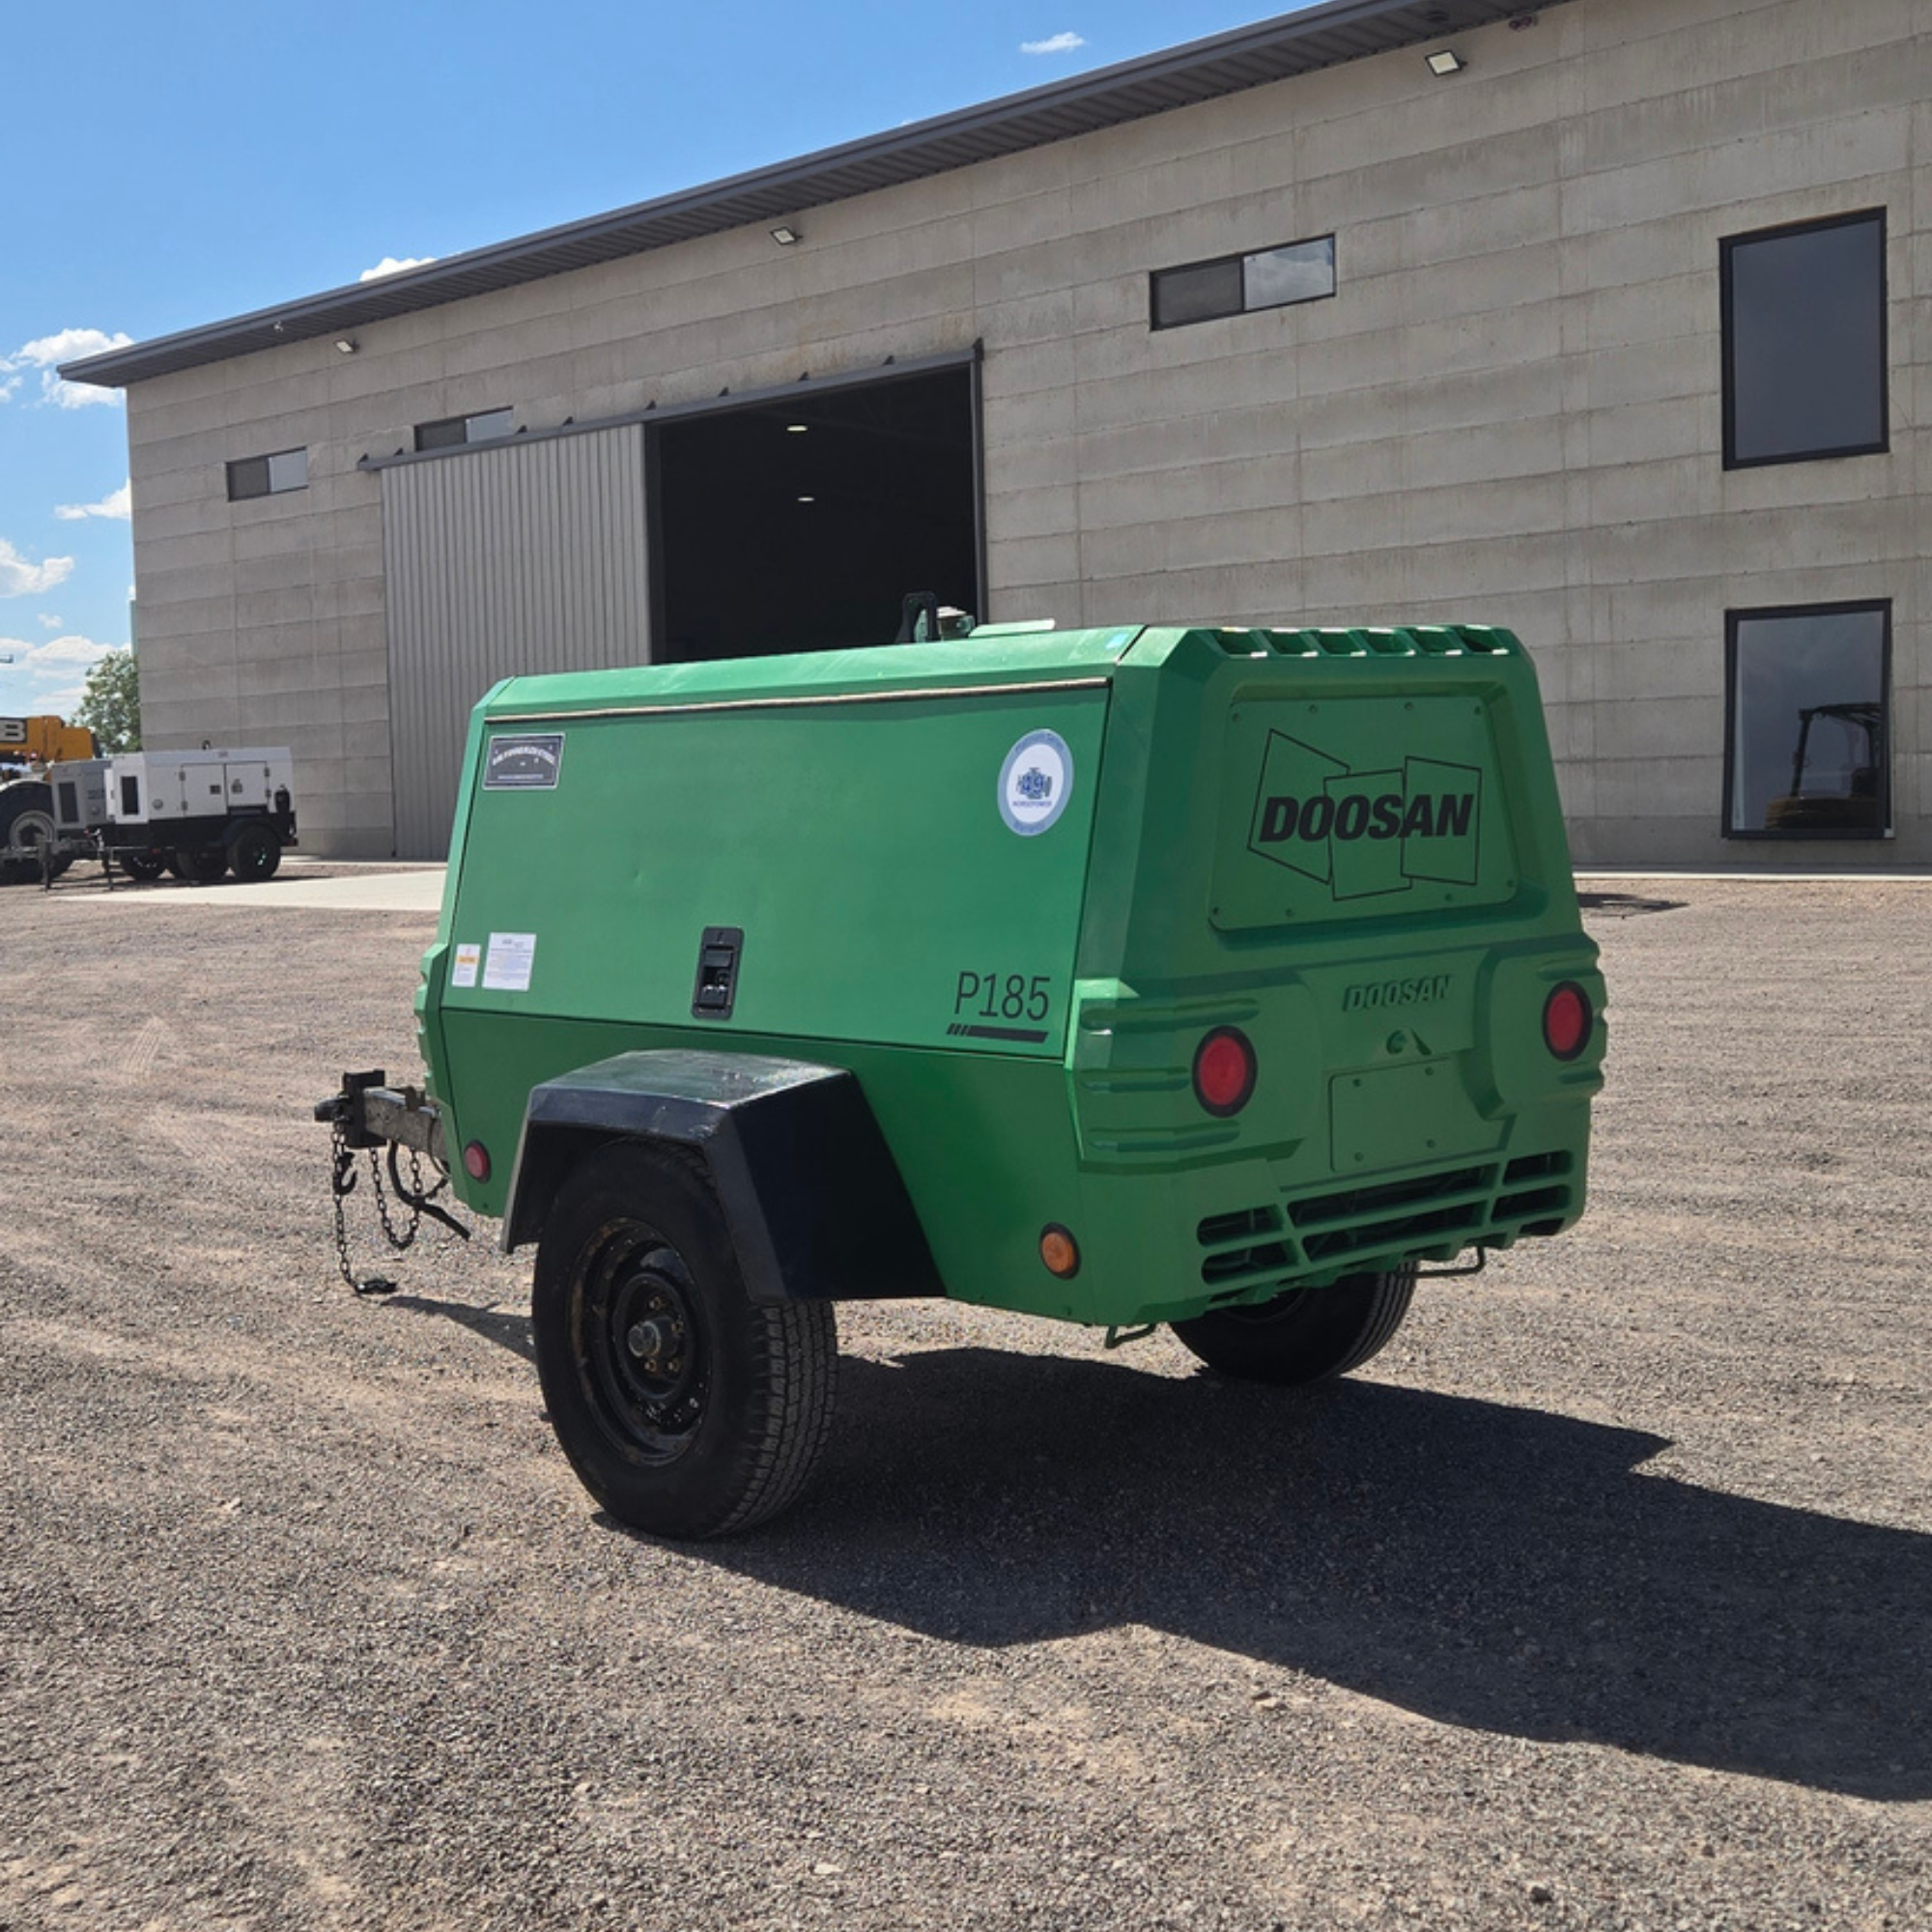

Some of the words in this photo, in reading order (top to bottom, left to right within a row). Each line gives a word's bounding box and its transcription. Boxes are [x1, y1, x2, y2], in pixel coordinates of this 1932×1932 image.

[1258, 794, 1474, 842] DOOSAN
[954, 970, 1050, 1021] P185
[1342, 975, 1450, 1011] DOOSAN
